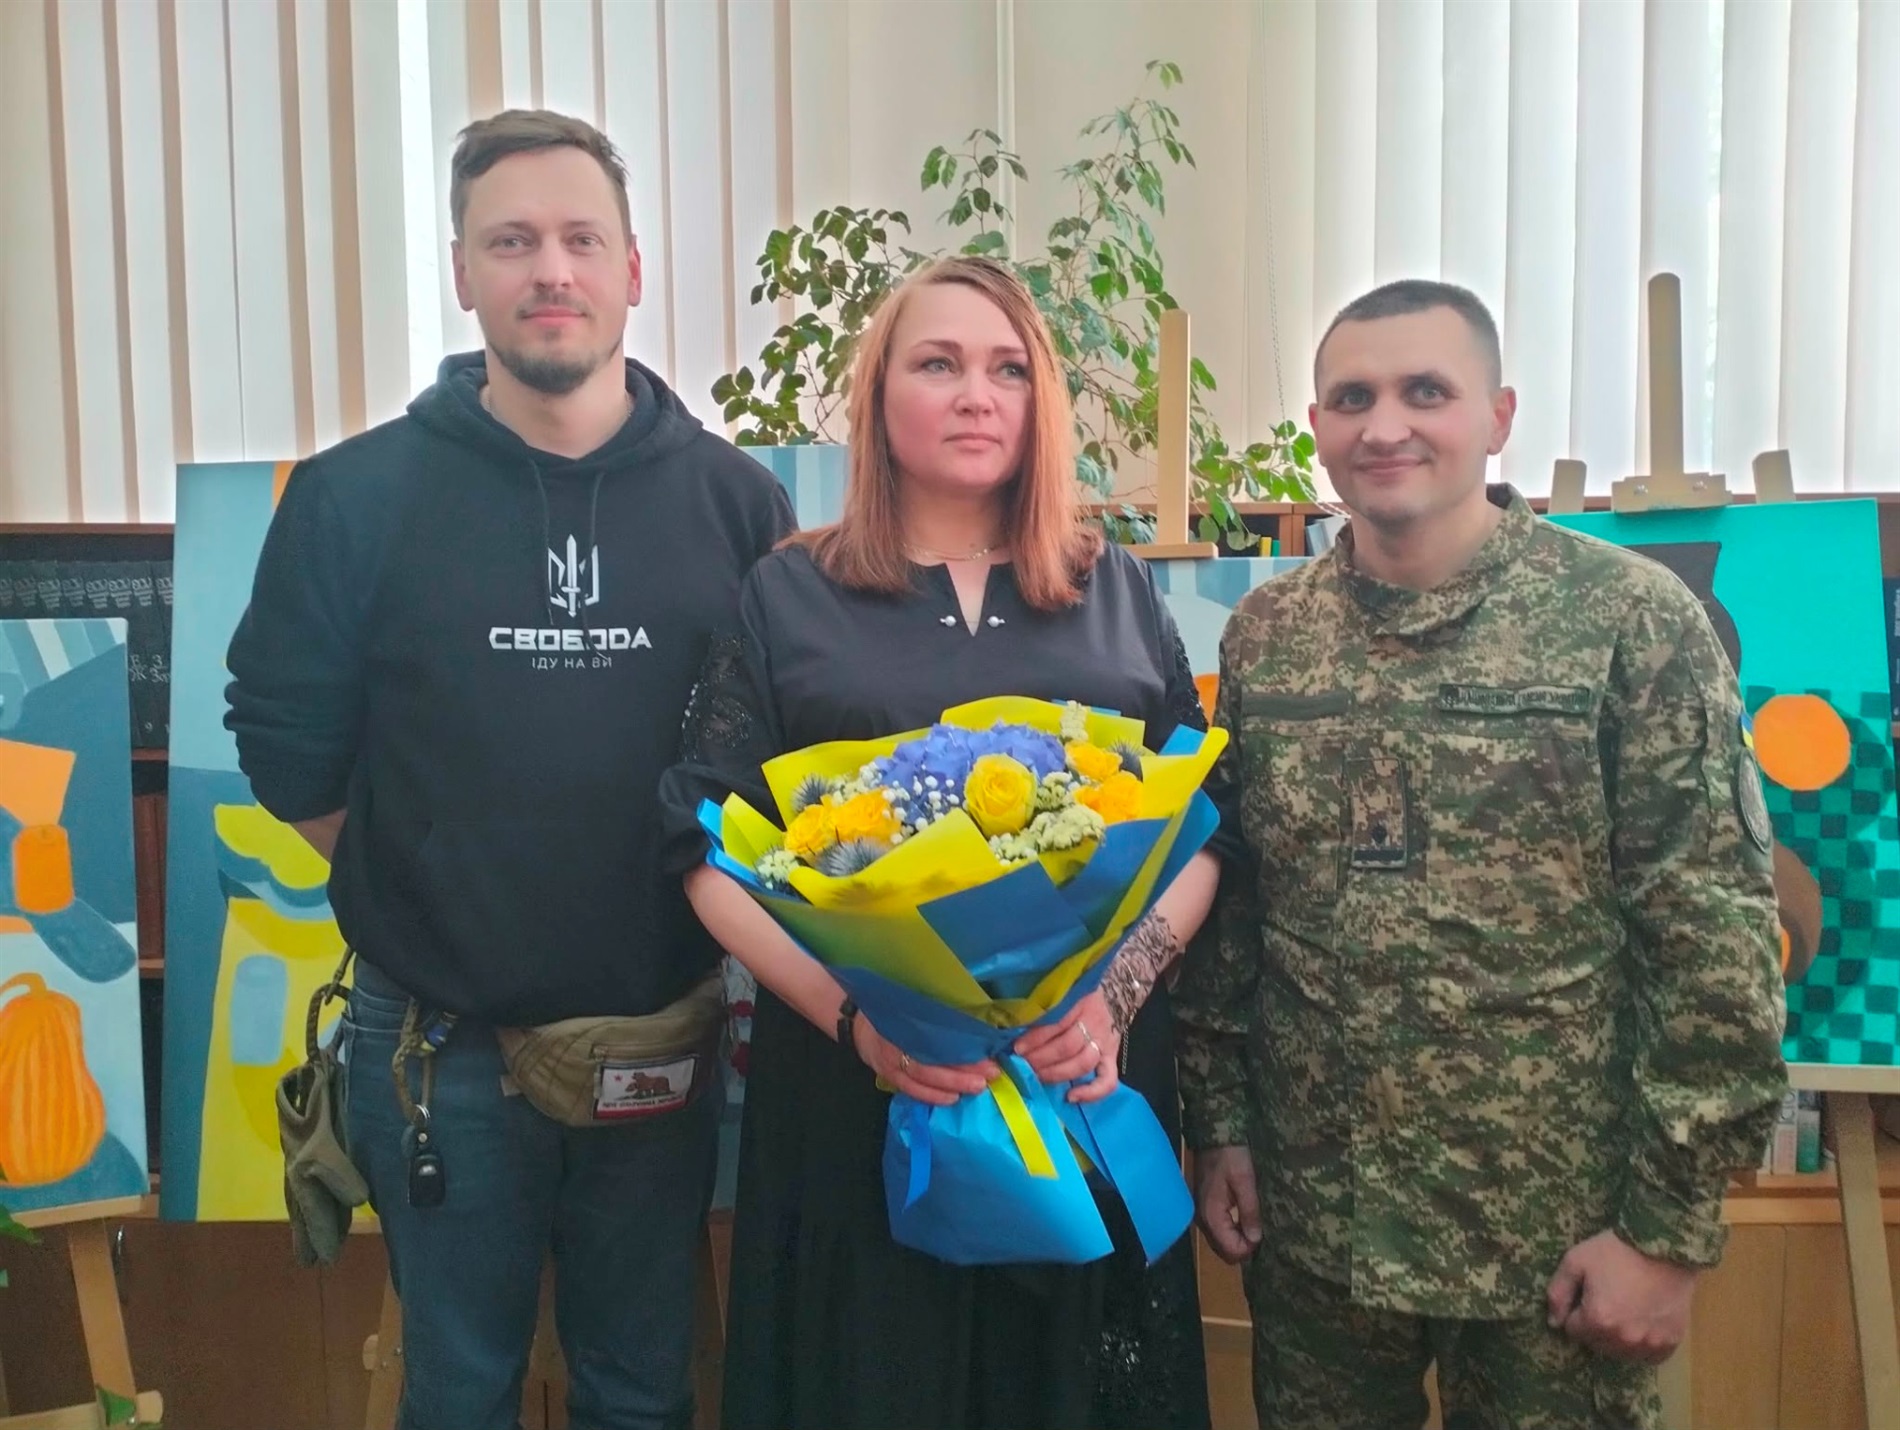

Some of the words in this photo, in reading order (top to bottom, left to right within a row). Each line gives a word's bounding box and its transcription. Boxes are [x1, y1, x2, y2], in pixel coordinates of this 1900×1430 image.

[489, 626, 653, 651] СВОБОДА
[532, 657, 558, 670] ІДУ
[565, 658, 585, 668] НА
[592, 657, 612, 668] ВИ
